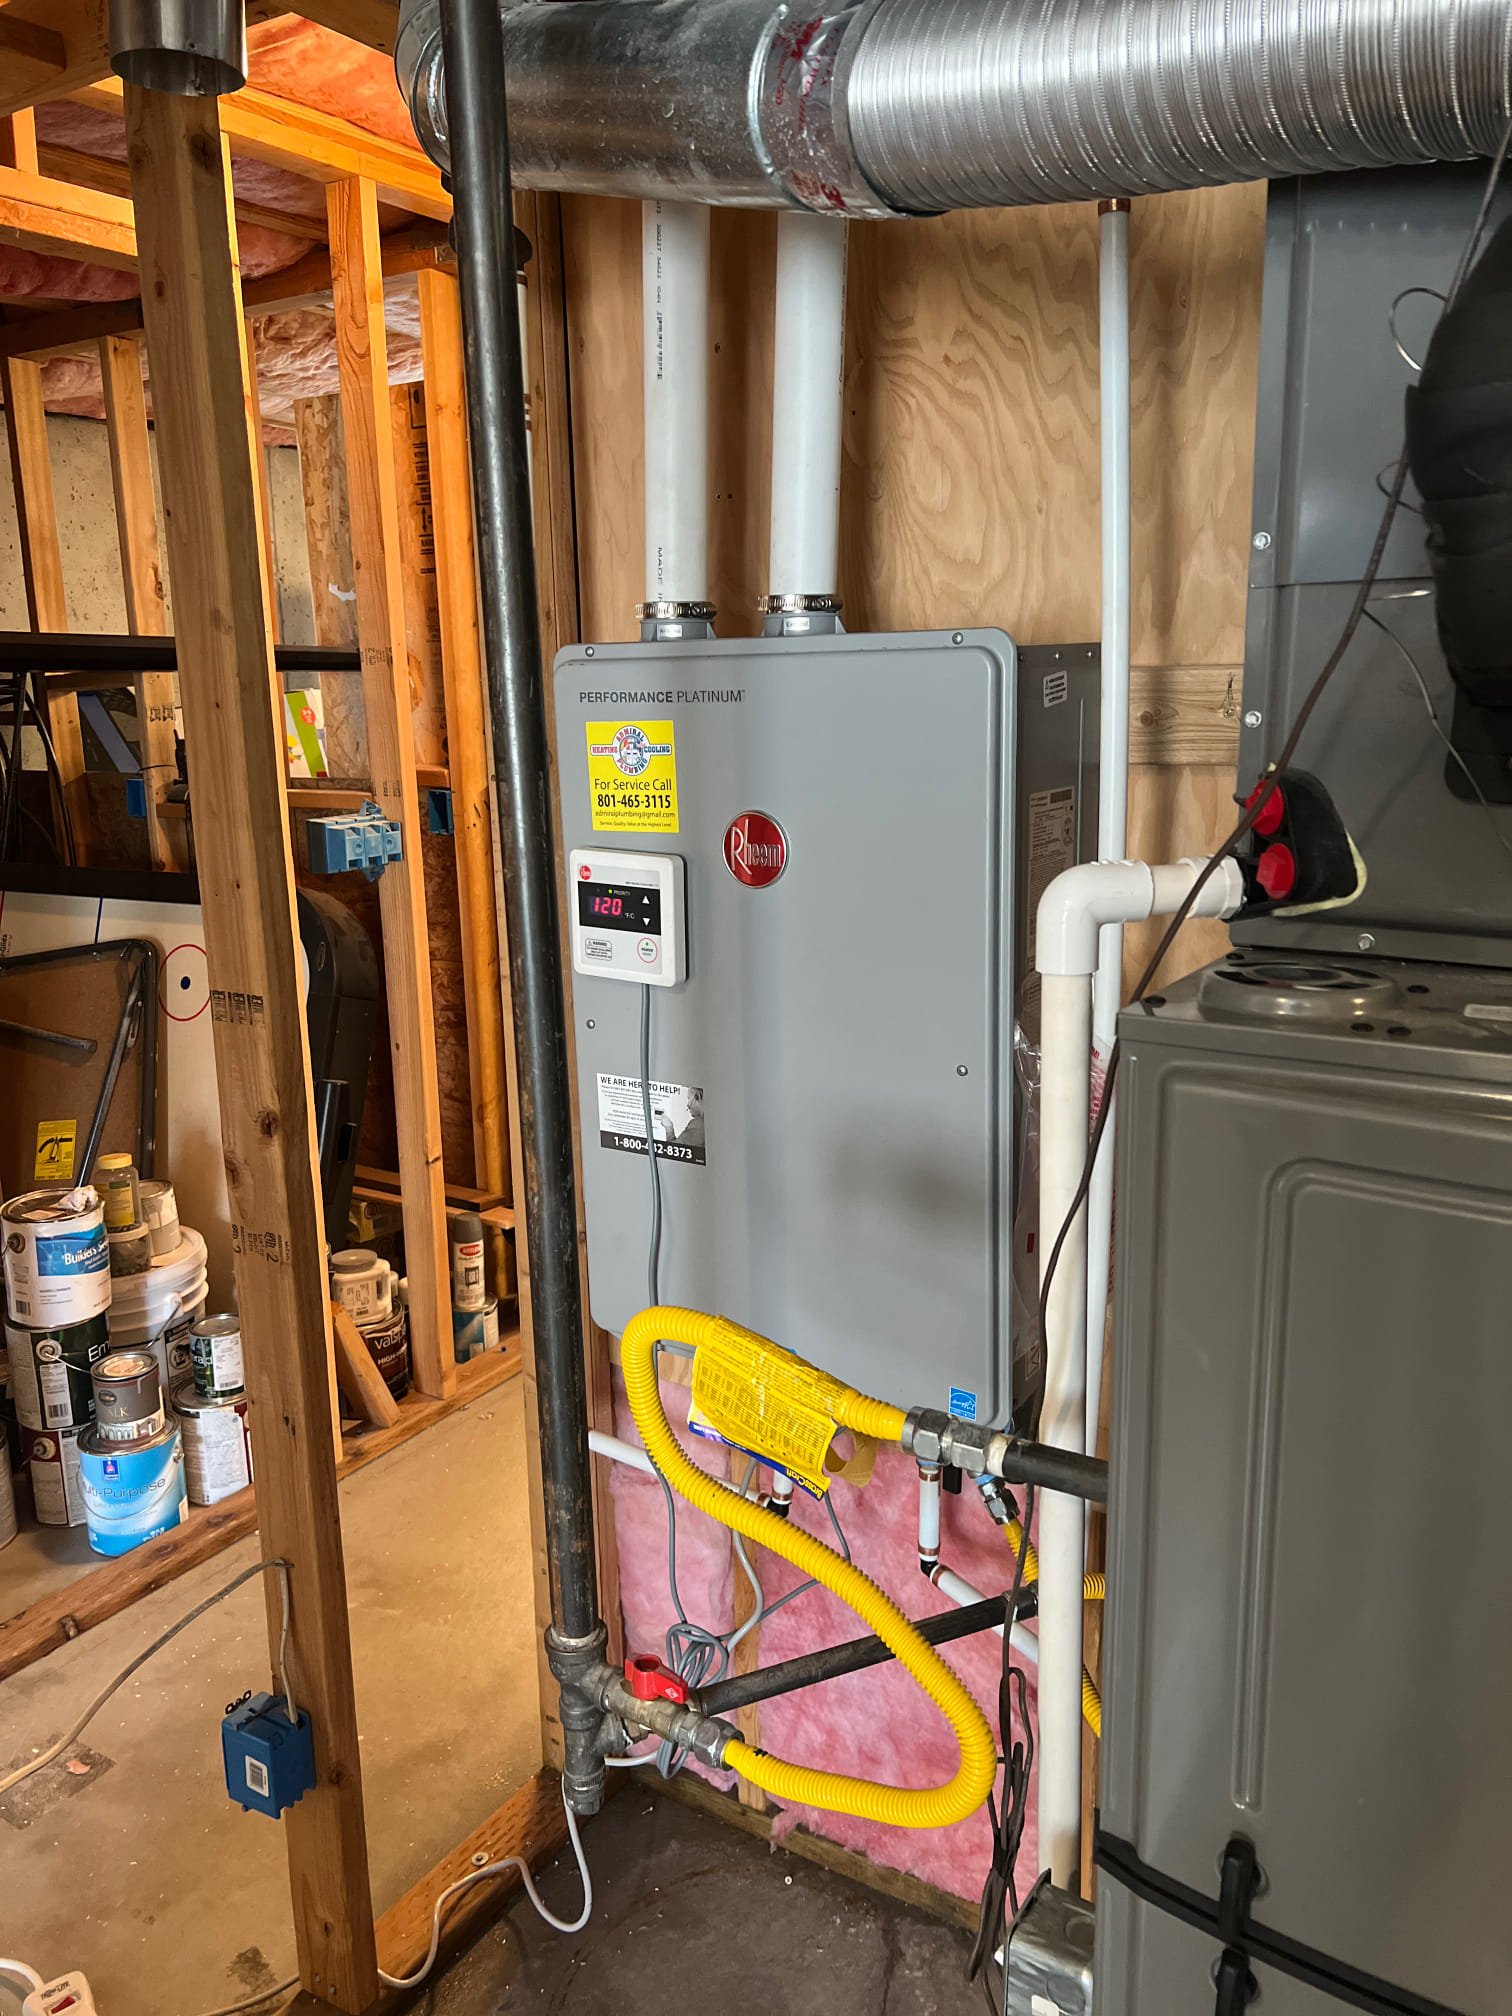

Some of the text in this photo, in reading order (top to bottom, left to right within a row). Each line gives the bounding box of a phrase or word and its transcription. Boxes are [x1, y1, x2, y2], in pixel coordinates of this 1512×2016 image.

[579, 691, 673, 703] PERFORMANCE
[616, 728, 644, 742] ADMIRAL
[592, 746, 671, 754] HEATING COOLING
[616, 758, 648, 773] PLUMBING
[594, 778, 672, 791] For Service Call
[597, 794, 671, 809] 801-465-3115
[595, 810, 675, 820] admiralplumbing@gmail.com
[731, 818, 782, 876] Rheem
[593, 896, 623, 917] 120
[600, 1076, 681, 1095] WE ARE HER TO HELP!
[784, 1467, 824, 1499] BrassCraft
